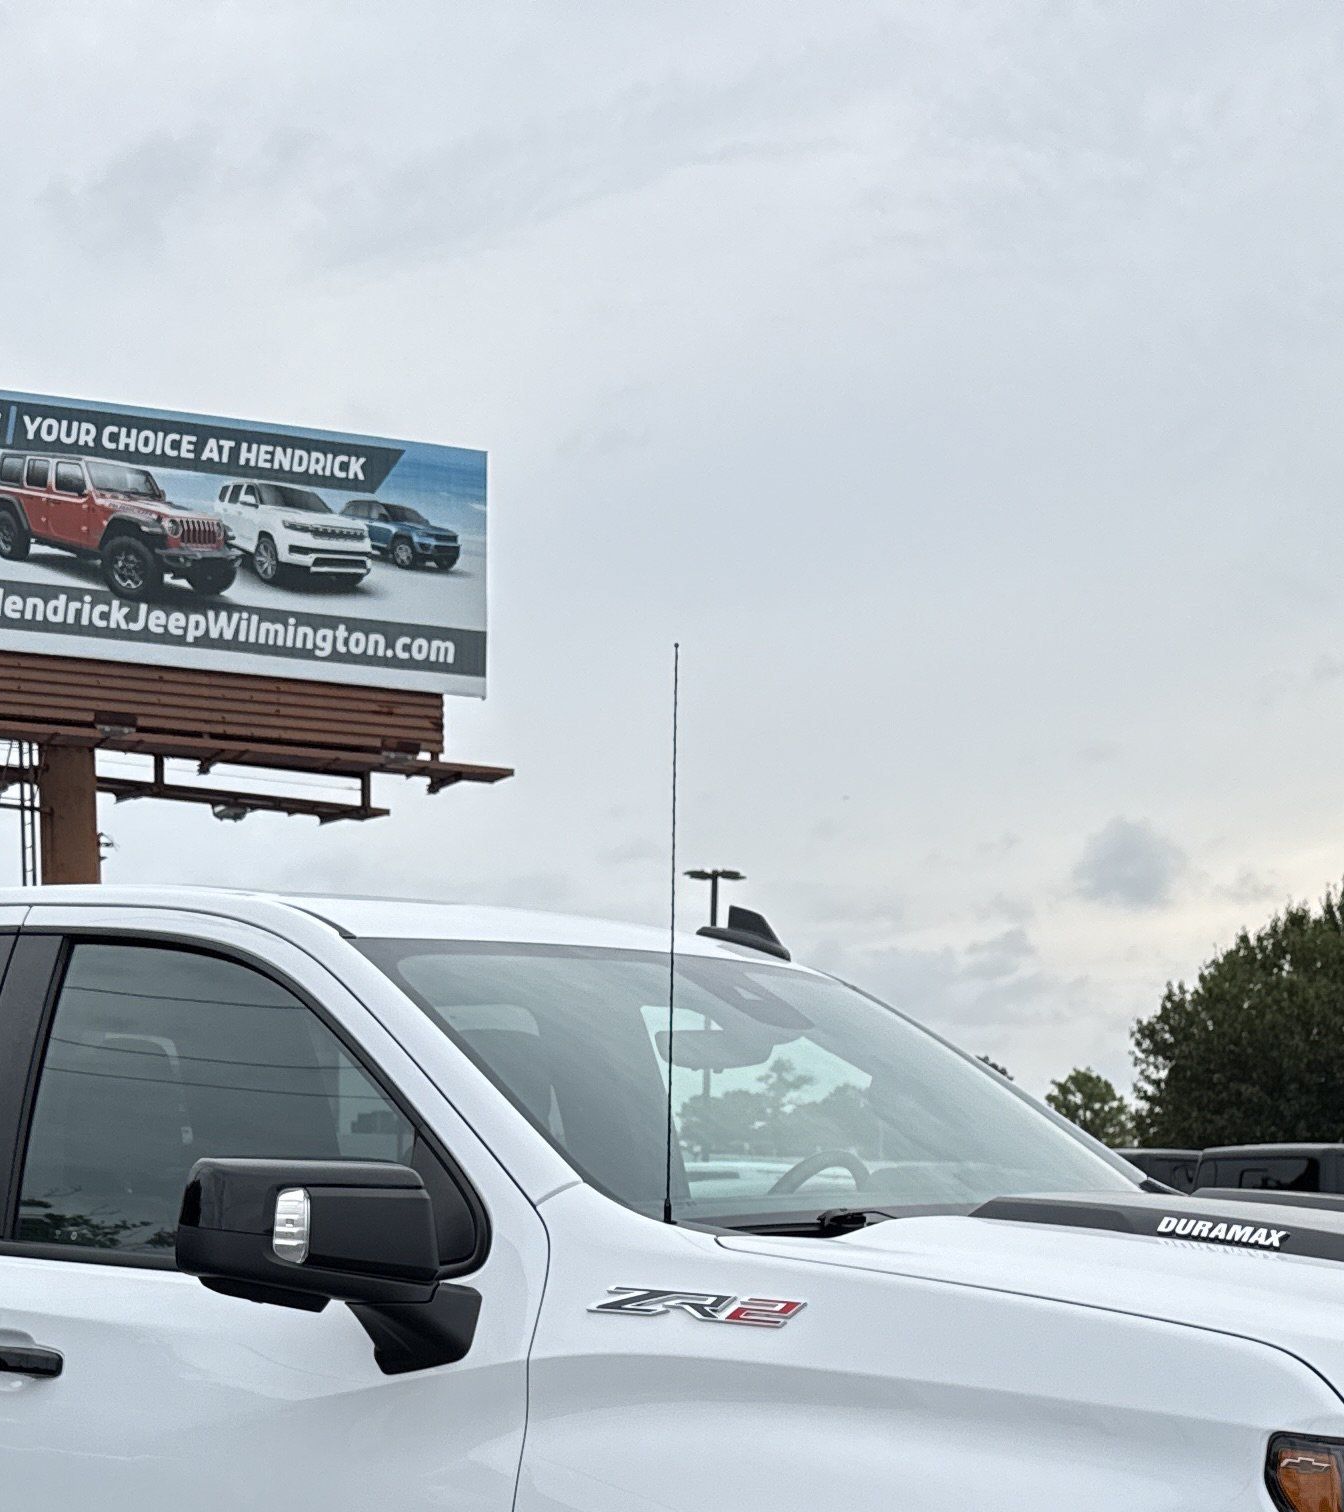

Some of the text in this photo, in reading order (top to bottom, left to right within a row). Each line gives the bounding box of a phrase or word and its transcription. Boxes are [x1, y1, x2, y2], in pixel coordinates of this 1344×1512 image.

[23, 415, 95, 447] YOUR
[102, 425, 197, 459] CHOICE
[201, 438, 236, 463] AT
[239, 442, 367, 481] HENDRICK
[1157, 1216, 1289, 1249] DURAMAX
[586, 1286, 808, 1328] ZR2
